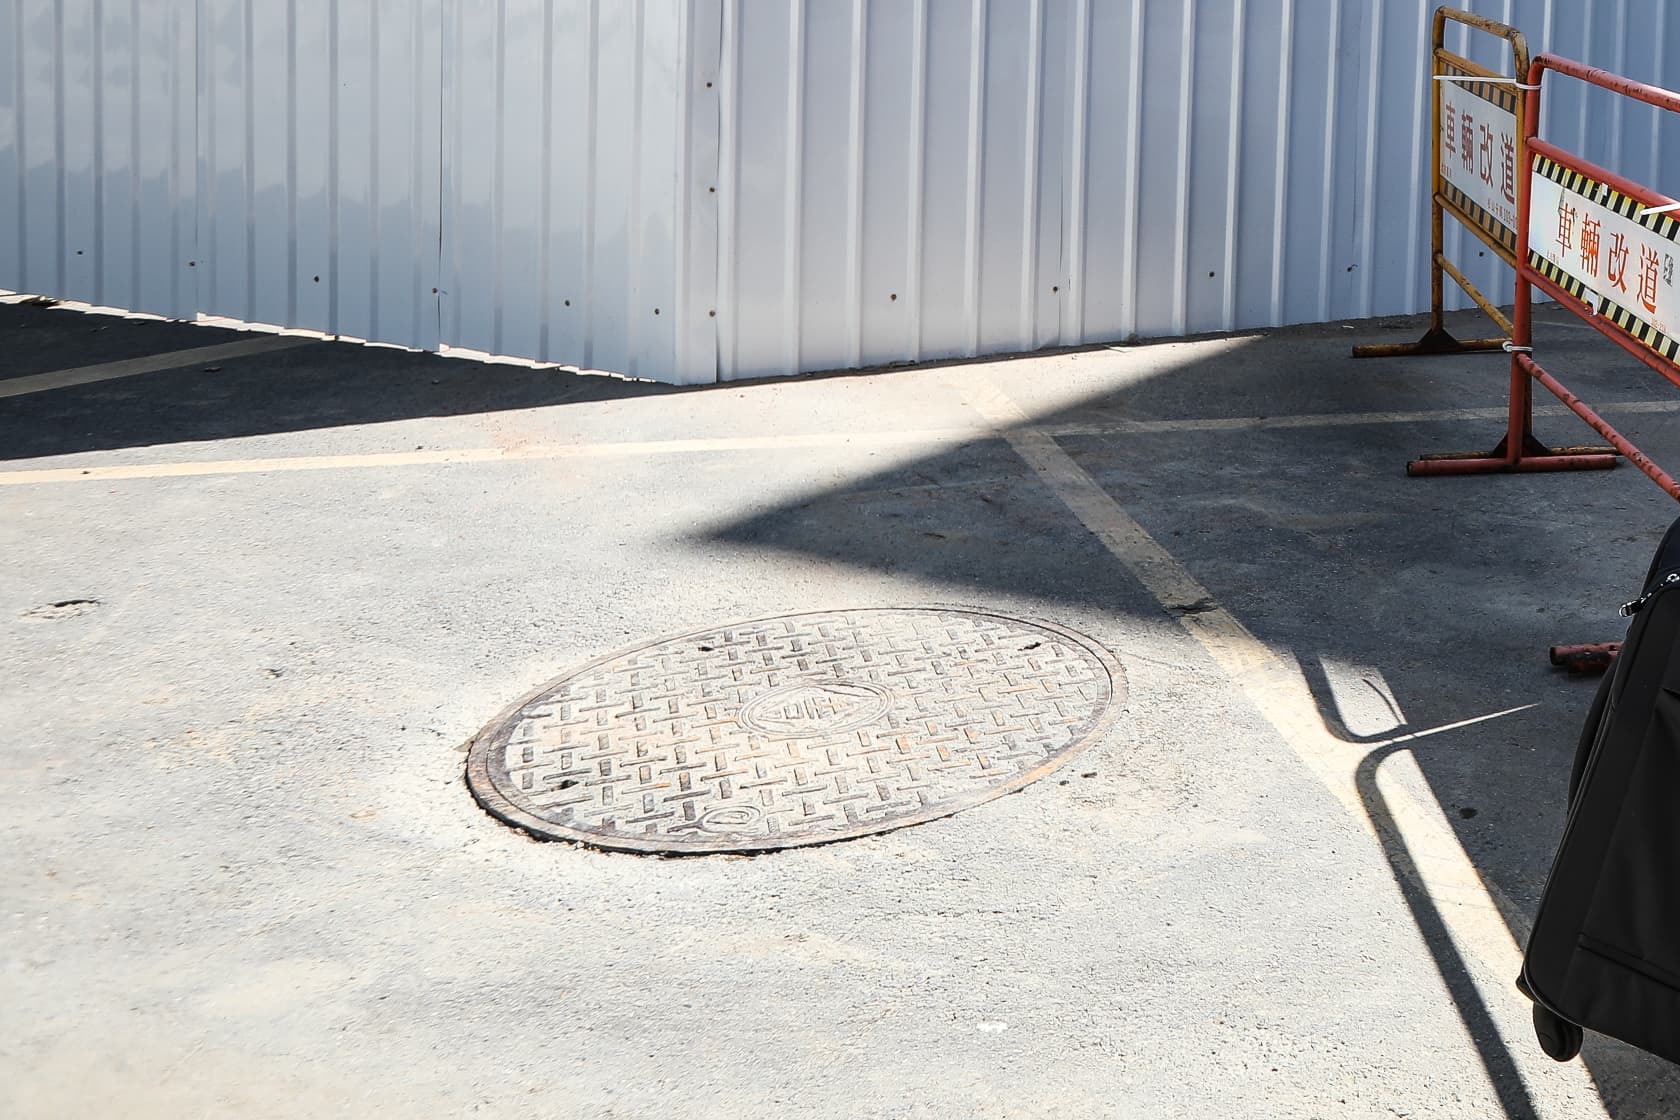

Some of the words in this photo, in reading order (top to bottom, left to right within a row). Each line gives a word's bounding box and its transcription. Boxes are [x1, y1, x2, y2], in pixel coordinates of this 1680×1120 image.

[1445, 101, 1515, 204] 車輛改道
[1556, 202, 1660, 314] 車輛改道
